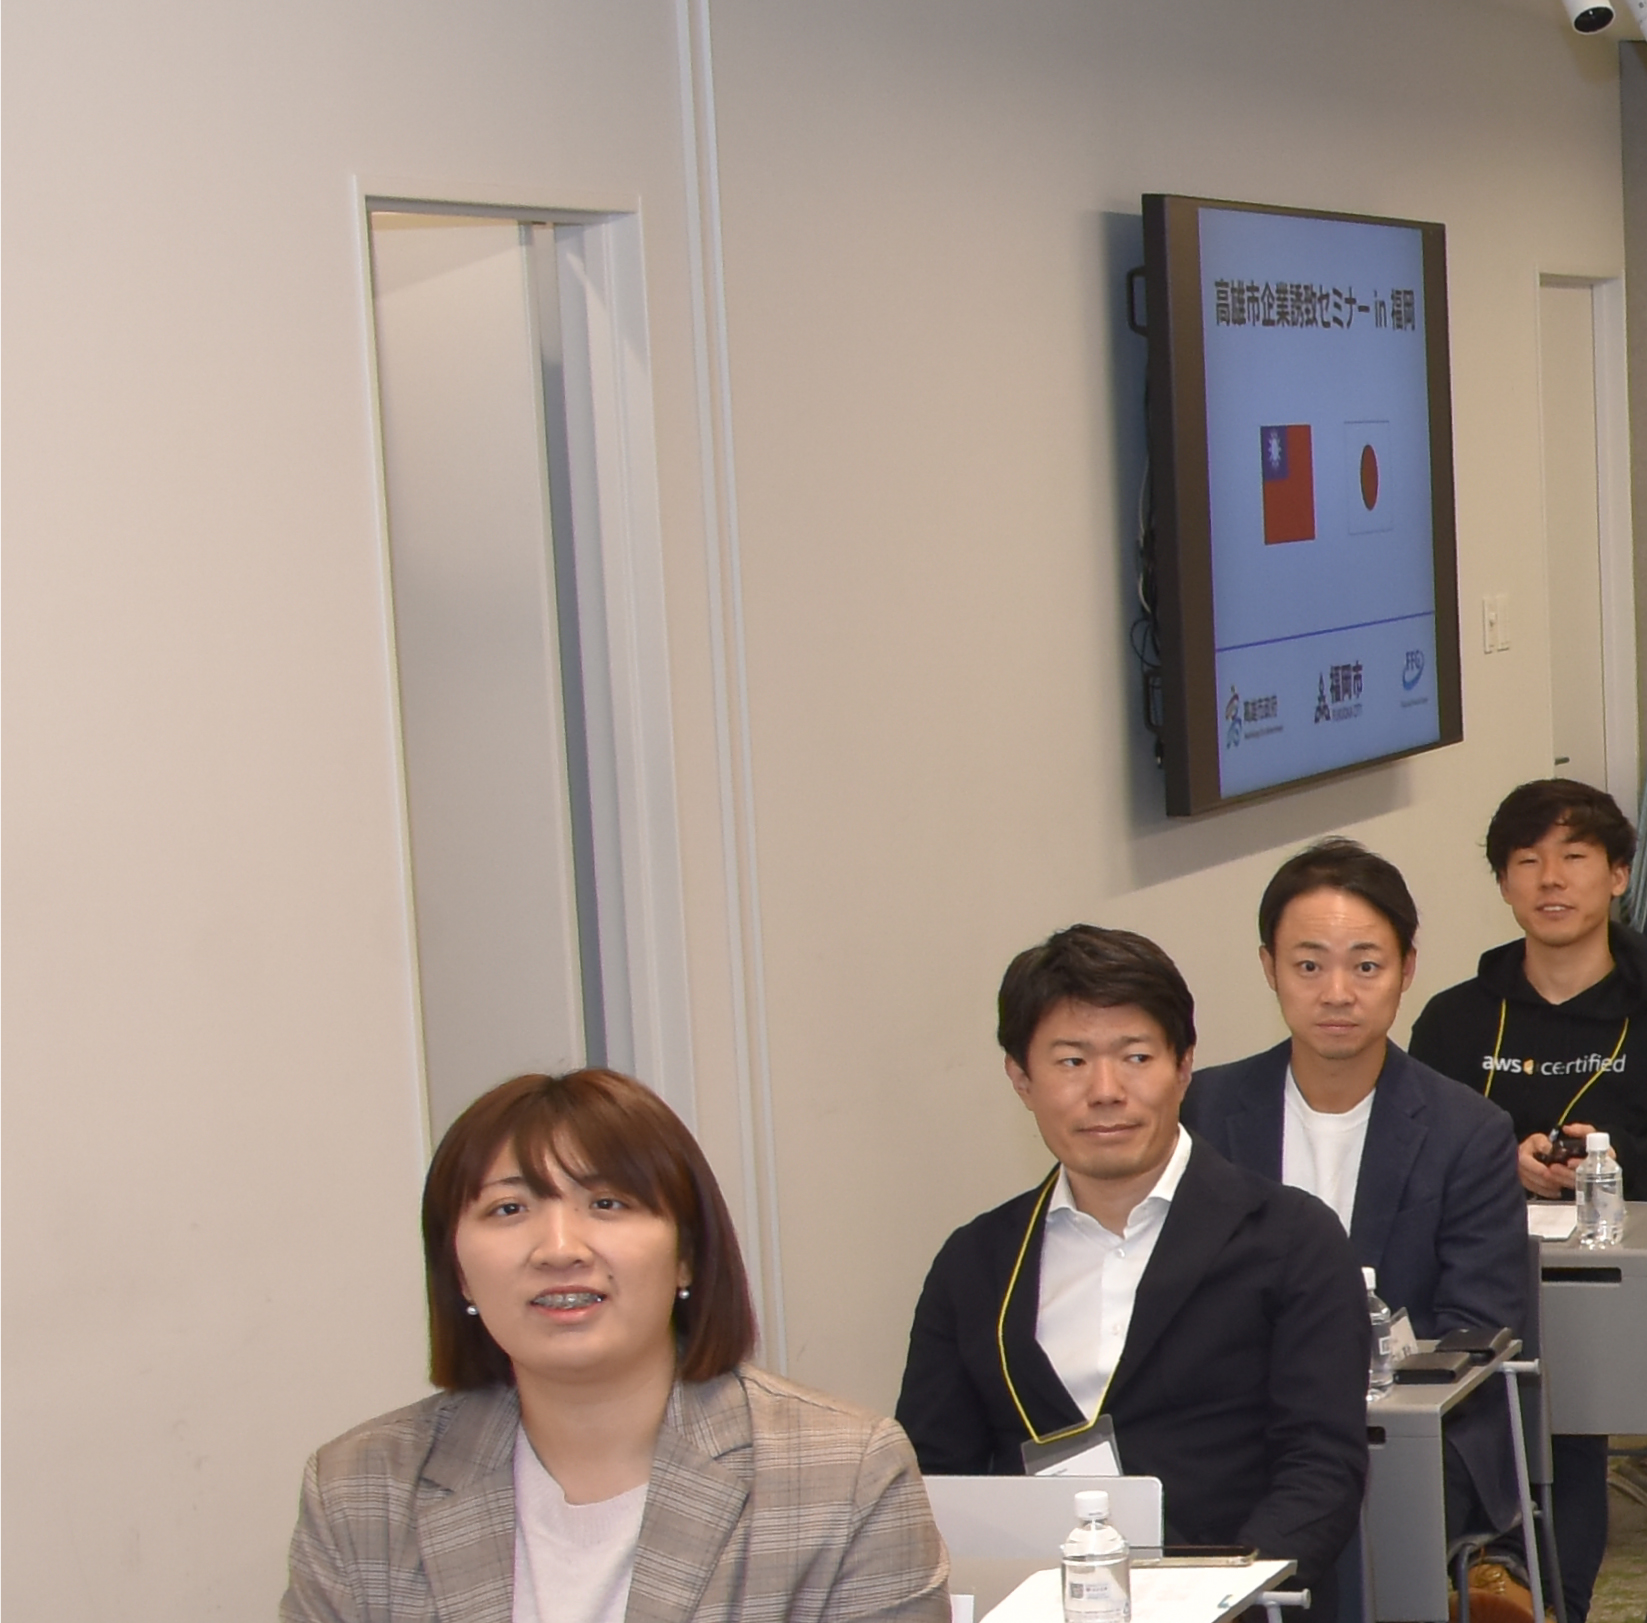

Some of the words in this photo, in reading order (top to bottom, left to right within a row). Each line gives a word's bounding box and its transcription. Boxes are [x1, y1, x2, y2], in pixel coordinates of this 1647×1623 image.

[1214, 278, 1371, 328] 高雄市企業誘致セミナー
[1374, 288, 1388, 329] in
[1391, 287, 1416, 332] 福岡
[1330, 660, 1363, 704] 福岡市
[1482, 1055, 1522, 1073] aws
[1540, 1053, 1627, 1076] certified
